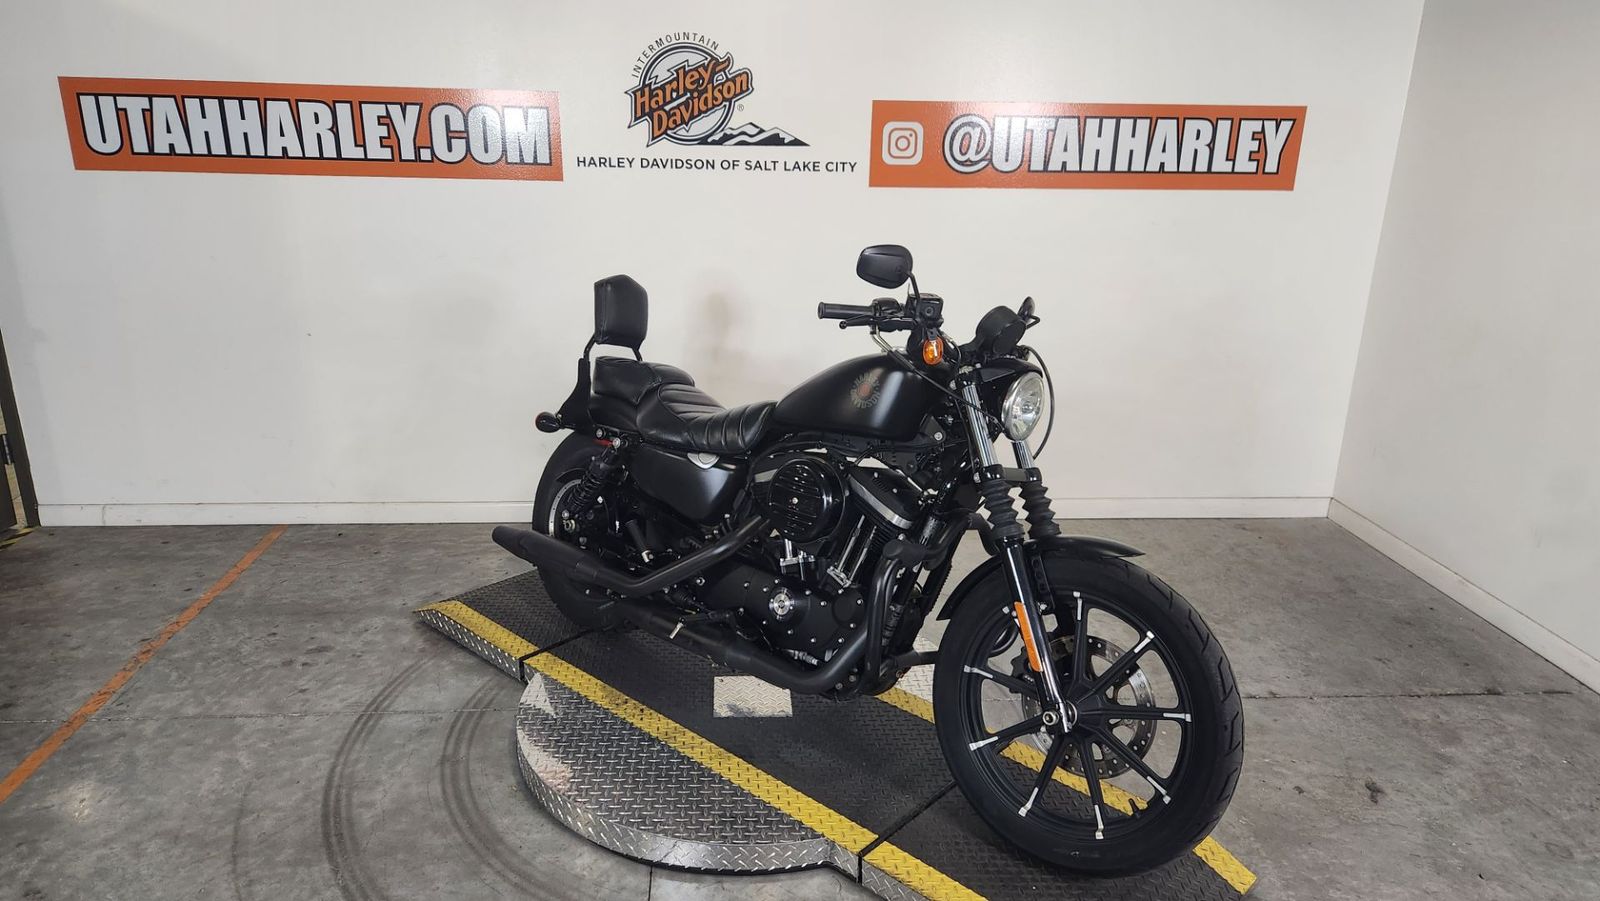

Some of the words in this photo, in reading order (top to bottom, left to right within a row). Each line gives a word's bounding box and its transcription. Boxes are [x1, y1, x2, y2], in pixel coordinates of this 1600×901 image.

[631, 31, 720, 78] INTERMOUNTAIN
[76, 92, 553, 166] UTAHHARLEY.COM
[652, 73, 750, 138] Davidson
[576, 156, 635, 169] HARLEY
[640, 158, 716, 171] DAVIDSON
[720, 159, 740, 171] OF
[744, 160, 779, 172] SALT
[783, 161, 821, 173] LAKE
[825, 161, 857, 173] CITY
[943, 114, 1297, 175] @UTAHHARLEY
